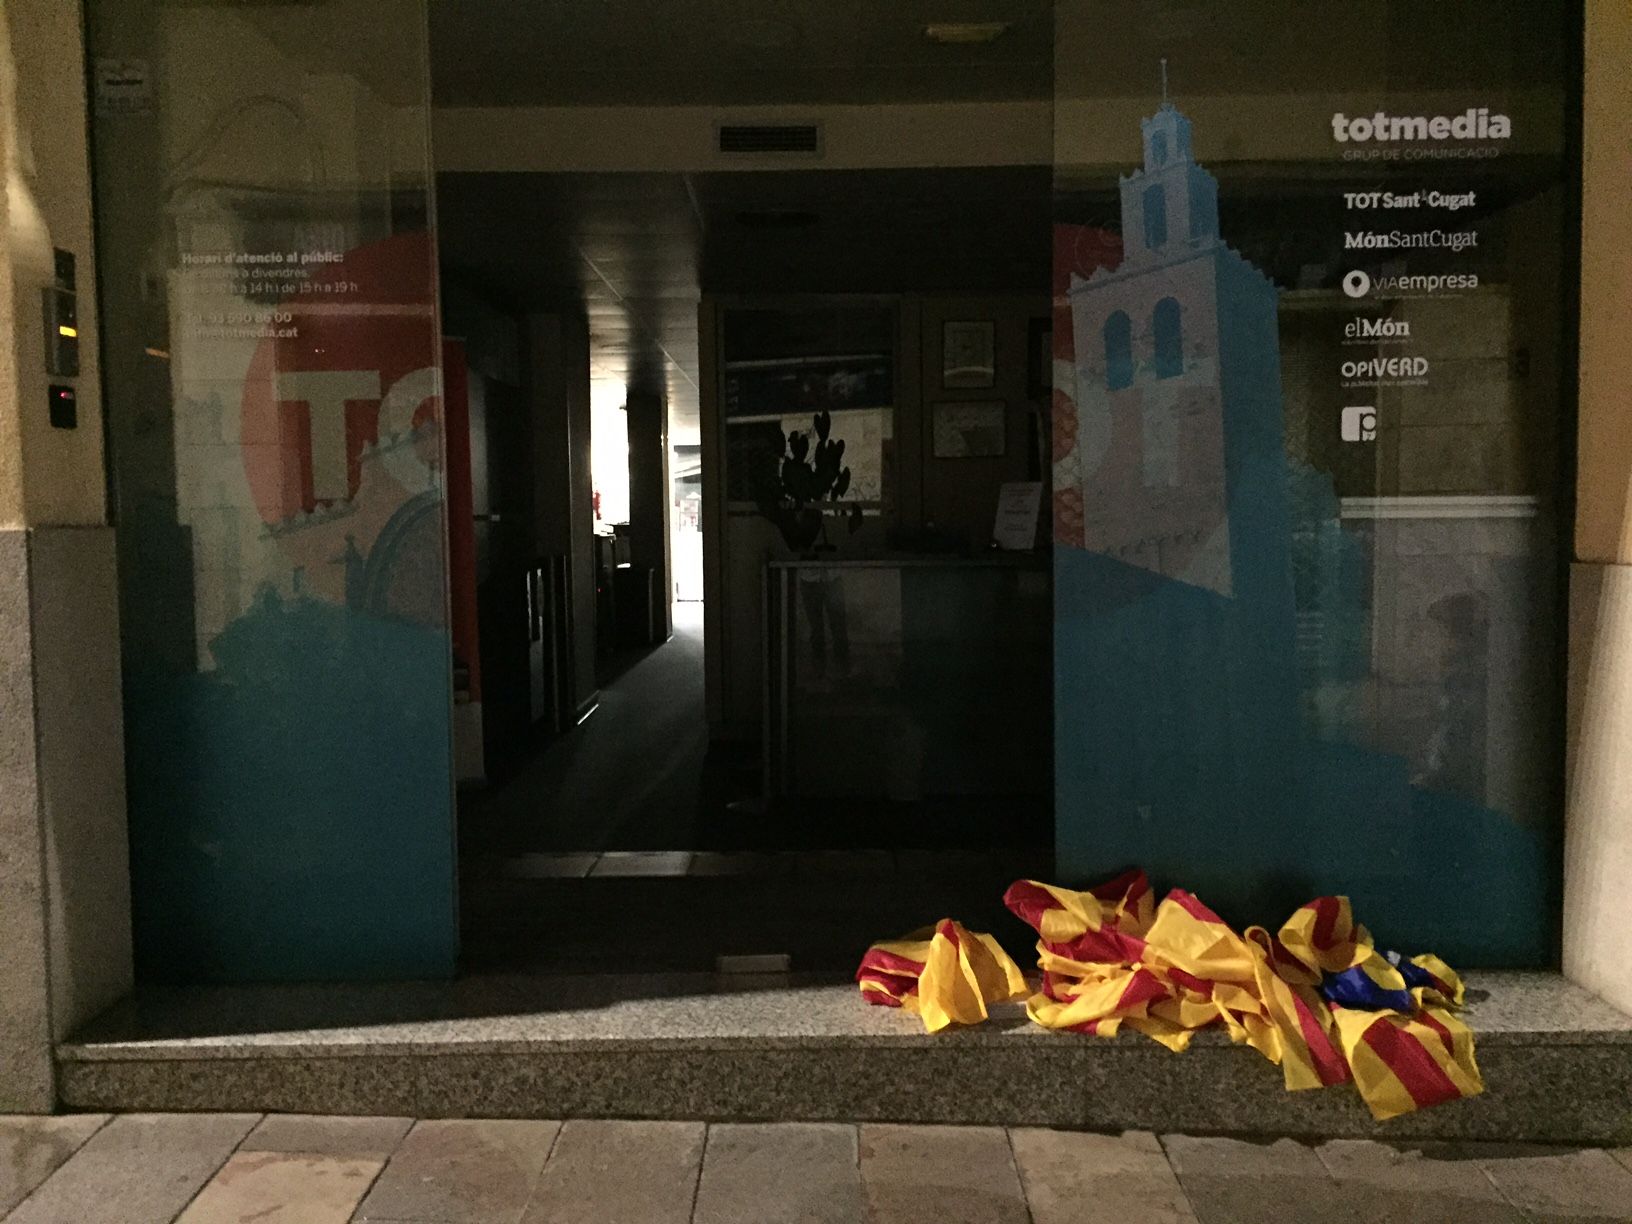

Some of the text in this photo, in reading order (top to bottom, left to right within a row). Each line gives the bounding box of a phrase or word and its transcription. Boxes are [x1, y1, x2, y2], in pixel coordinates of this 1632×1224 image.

[1332, 107, 1511, 143] totmedia
[1342, 150, 1380, 162] GRUP
[1383, 149, 1400, 160] DE
[1343, 191, 1476, 210] TOT Sant Cugat
[182, 251, 344, 265] Horari d'atenció al públic:
[250, 282, 262, 293] 14
[265, 282, 274, 293] h
[281, 282, 296, 293] de
[314, 282, 322, 292] h
[334, 281, 348, 292] 19
[350, 281, 358, 292] h
[273, 311, 292, 323] 00
[1344, 317, 1410, 338] elMón
[1341, 356, 1429, 378] OPIVERD
